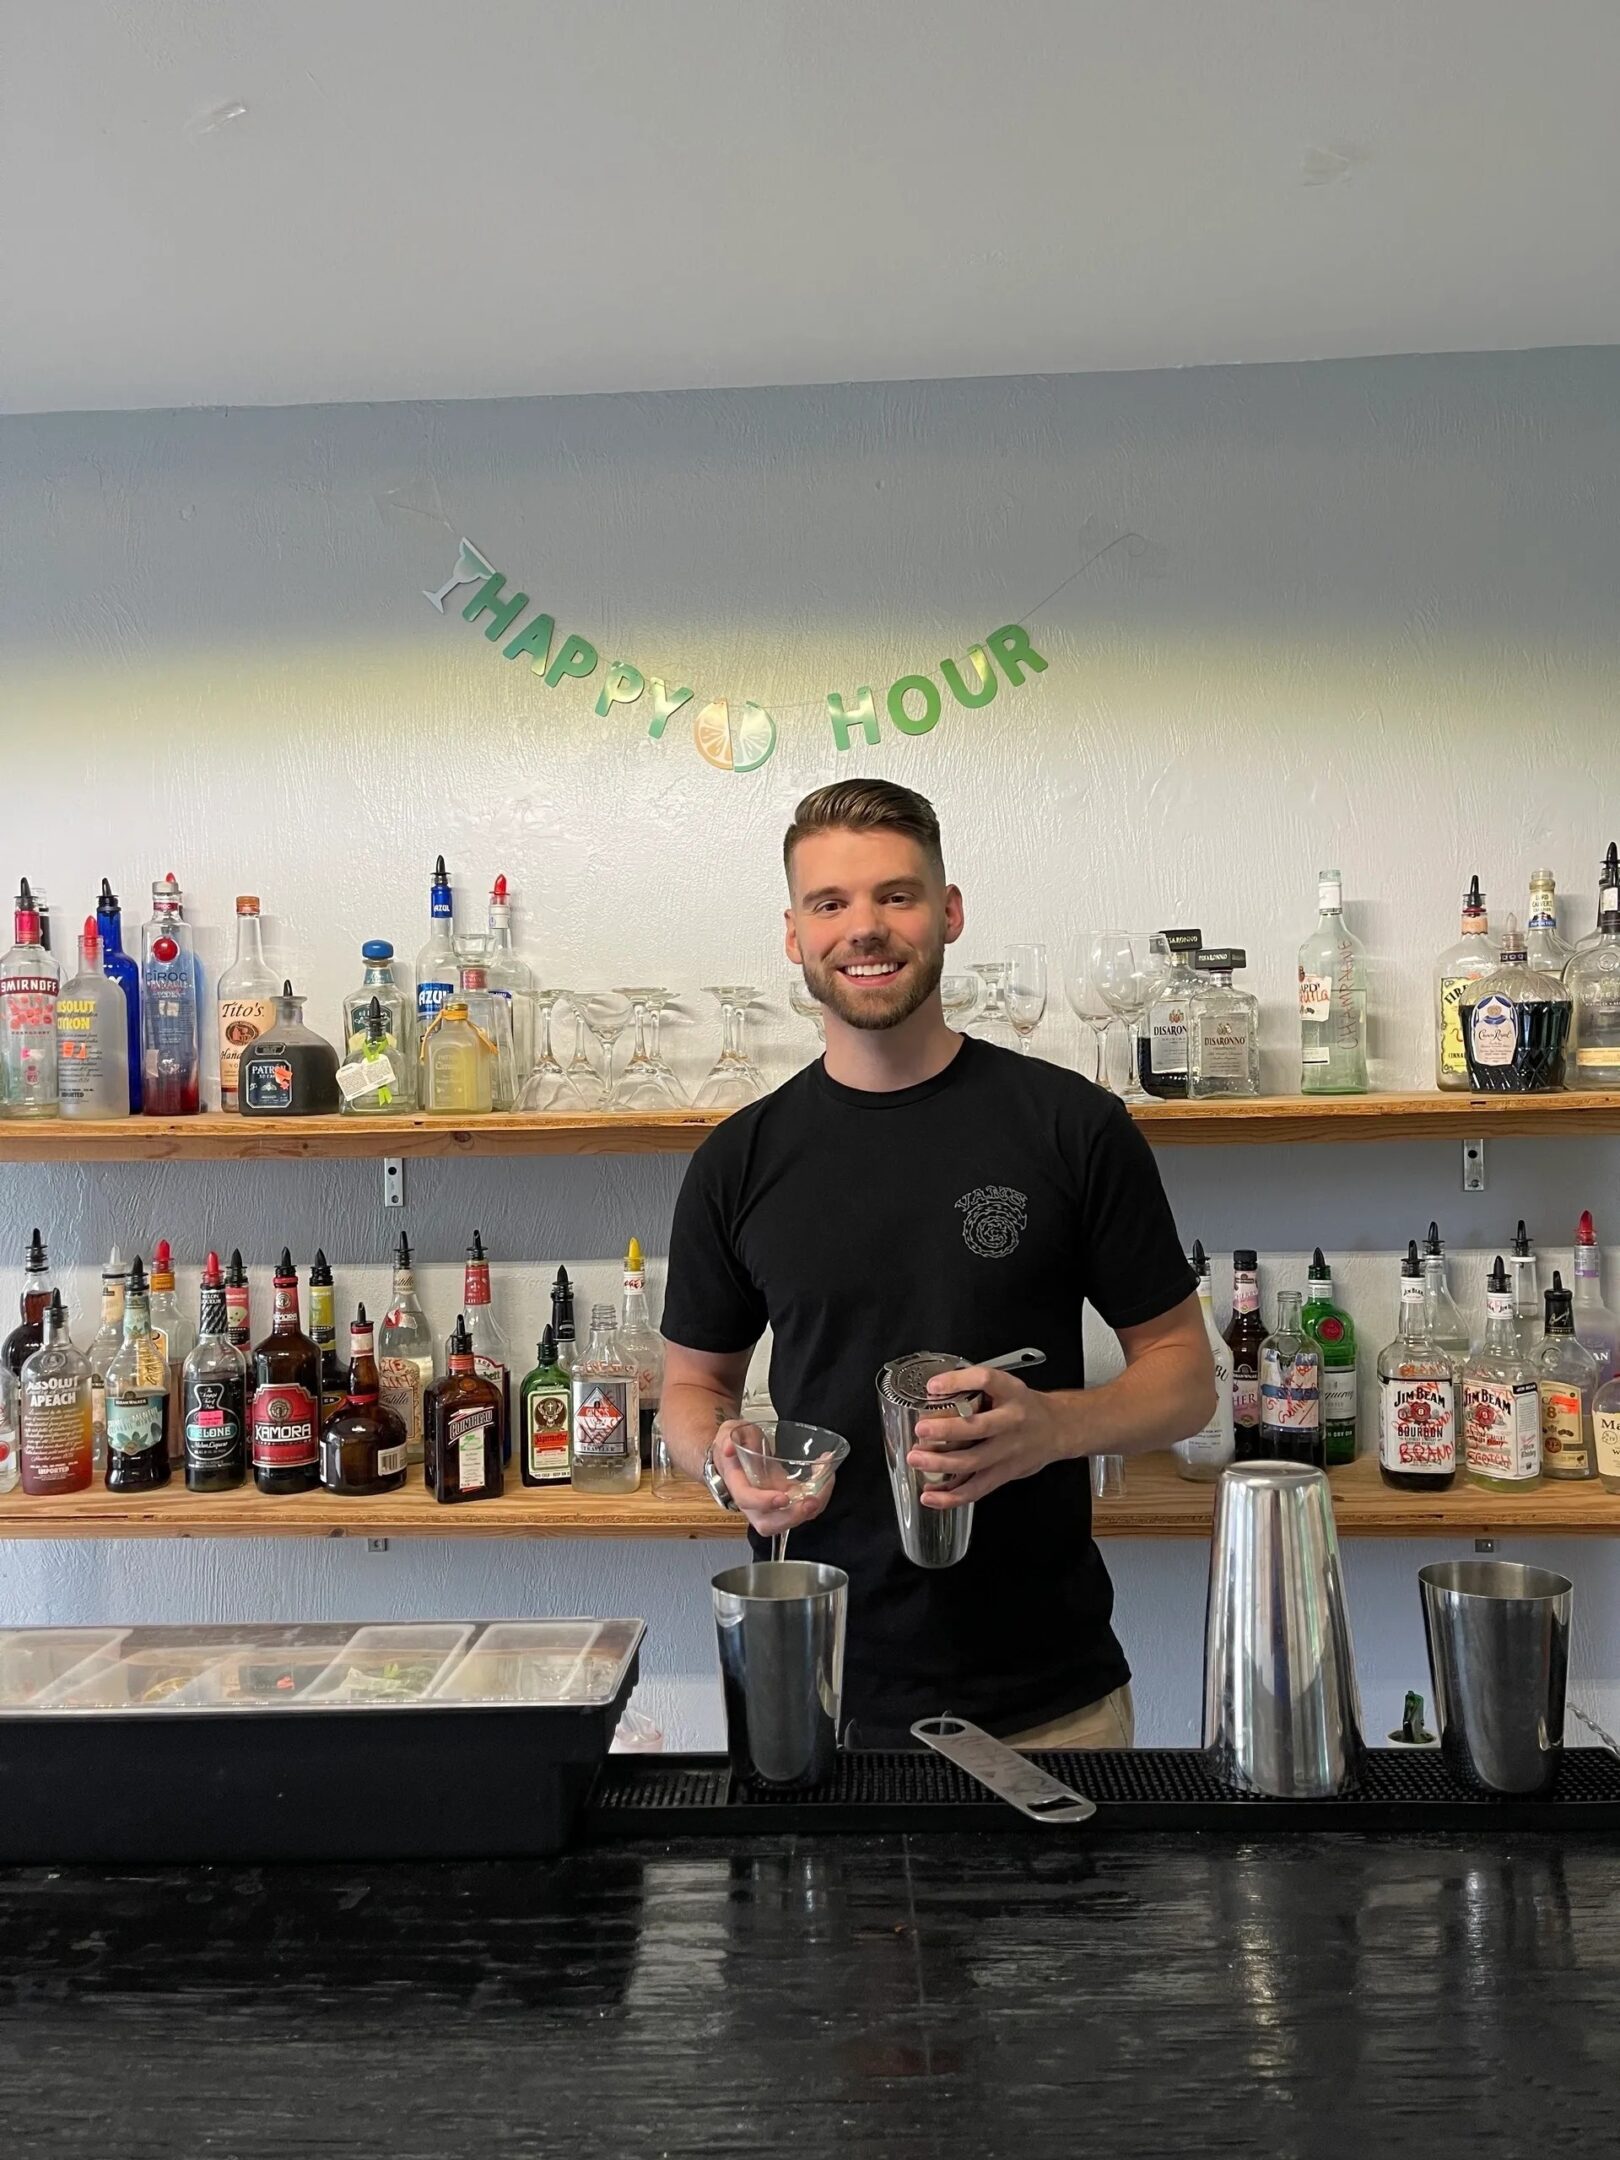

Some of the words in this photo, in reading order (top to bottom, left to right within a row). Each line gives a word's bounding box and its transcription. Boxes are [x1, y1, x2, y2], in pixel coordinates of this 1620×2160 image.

[461, 572, 694, 739] HAPPY
[826, 623, 1049, 751] HOUR
[433, 904, 451, 912] AZUL
[1168, 936, 1198, 944] SARONNO
[1, 979, 57, 993] SMIRNOFF
[222, 1001, 264, 1018] Tito's
[1153, 1025, 1188, 1036] DISARON
[1204, 1037, 1245, 1046] DISARONNO
[27, 1375, 80, 1390] ABSOLUT
[30, 1392, 77, 1407] APEACH
[1394, 1390, 1414, 1407] JIM
[1416, 1387, 1446, 1409] BEAM
[1464, 1386, 1480, 1407] JIM
[1481, 1388, 1511, 1416] BEAM
[255, 1423, 312, 1440] KAMORA
[449, 1409, 493, 1441] COINTREAU
[1397, 1426, 1444, 1438] BOURBON
[38, 1466, 70, 1475] IMPORTED
